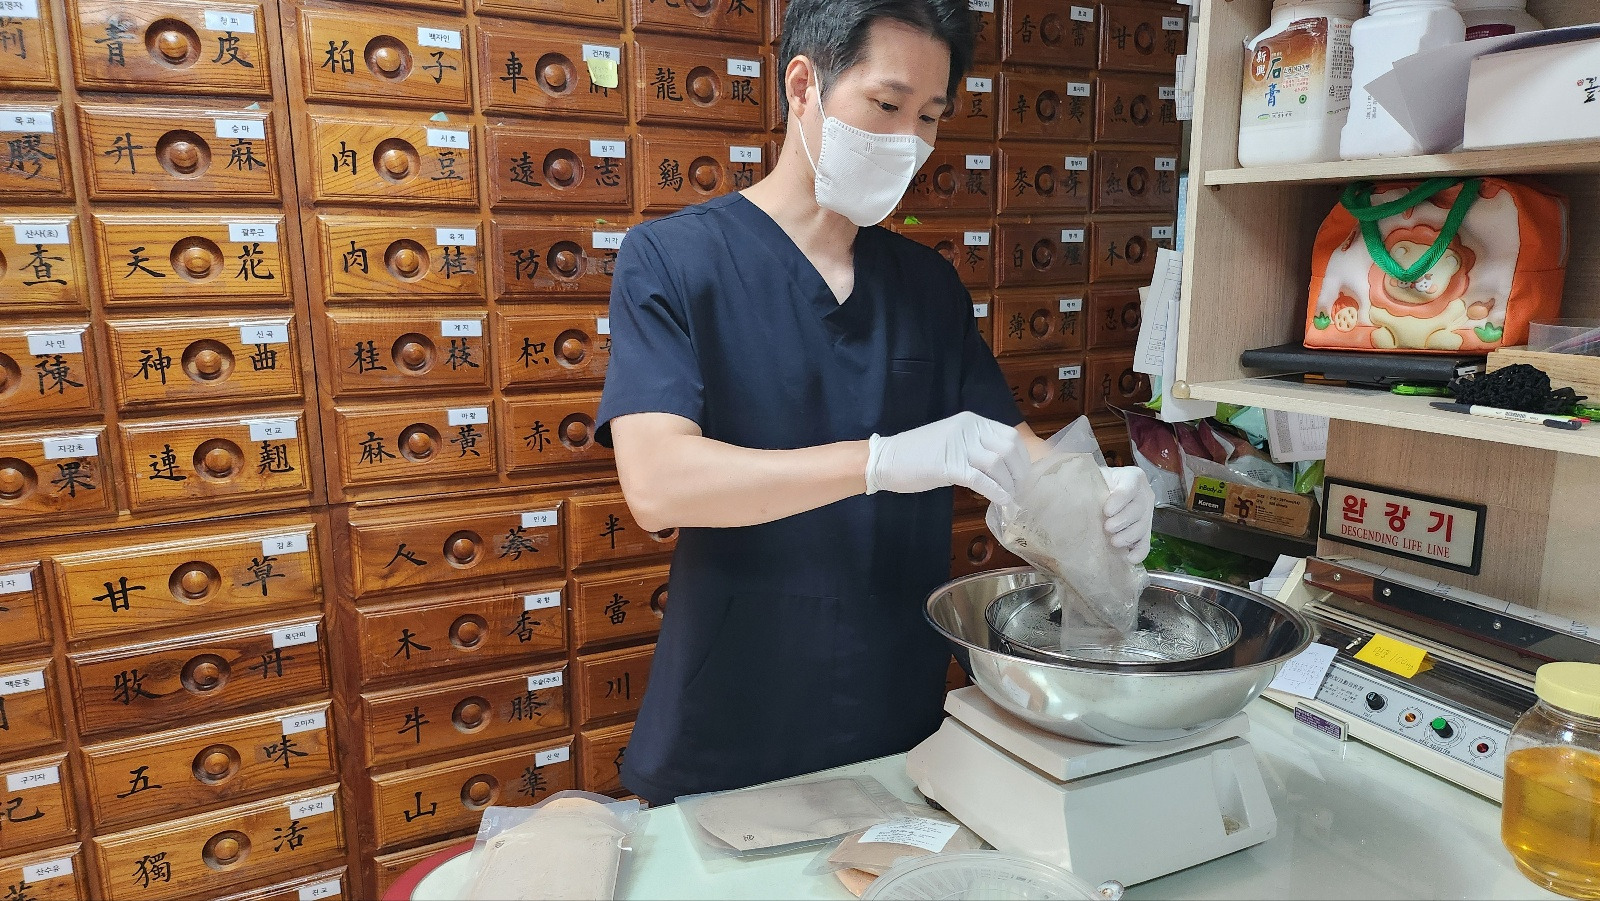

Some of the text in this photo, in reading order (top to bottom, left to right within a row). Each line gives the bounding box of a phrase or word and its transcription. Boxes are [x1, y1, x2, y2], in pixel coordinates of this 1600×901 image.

[212, 32, 254, 68] 皮
[1112, 26, 1131, 50] 甘
[422, 51, 456, 84] 子
[500, 51, 528, 93] 車
[650, 68, 683, 101] 龍
[231, 124, 249, 133] 승마
[332, 141, 463, 181] 肉 豆
[510, 152, 620, 187] 遠 志
[124, 242, 275, 281] 天 花
[343, 241, 474, 279] 肉 桂
[1105, 241, 1123, 266] 木
[133, 344, 278, 385] 神 曲
[348, 338, 479, 374] 桂 枝
[523, 421, 551, 452] 赤
[51, 462, 96, 498] 果
[149, 444, 187, 481] 連
[1198, 499, 1219, 509] Korean
[600, 514, 625, 549] 半
[1341, 524, 1450, 558] DESCENDING LIFE LINE
[92, 556, 285, 613] 甘 草
[604, 593, 630, 625] 當
[394, 611, 541, 660] 木 香
[605, 672, 630, 700] 川
[293, 719, 315, 728] 오미자
[398, 706, 430, 743] 牛
[21, 773, 46, 783] 구기자
[117, 735, 308, 799] 五 味
[404, 792, 437, 822] 山
[273, 821, 308, 852] 活
